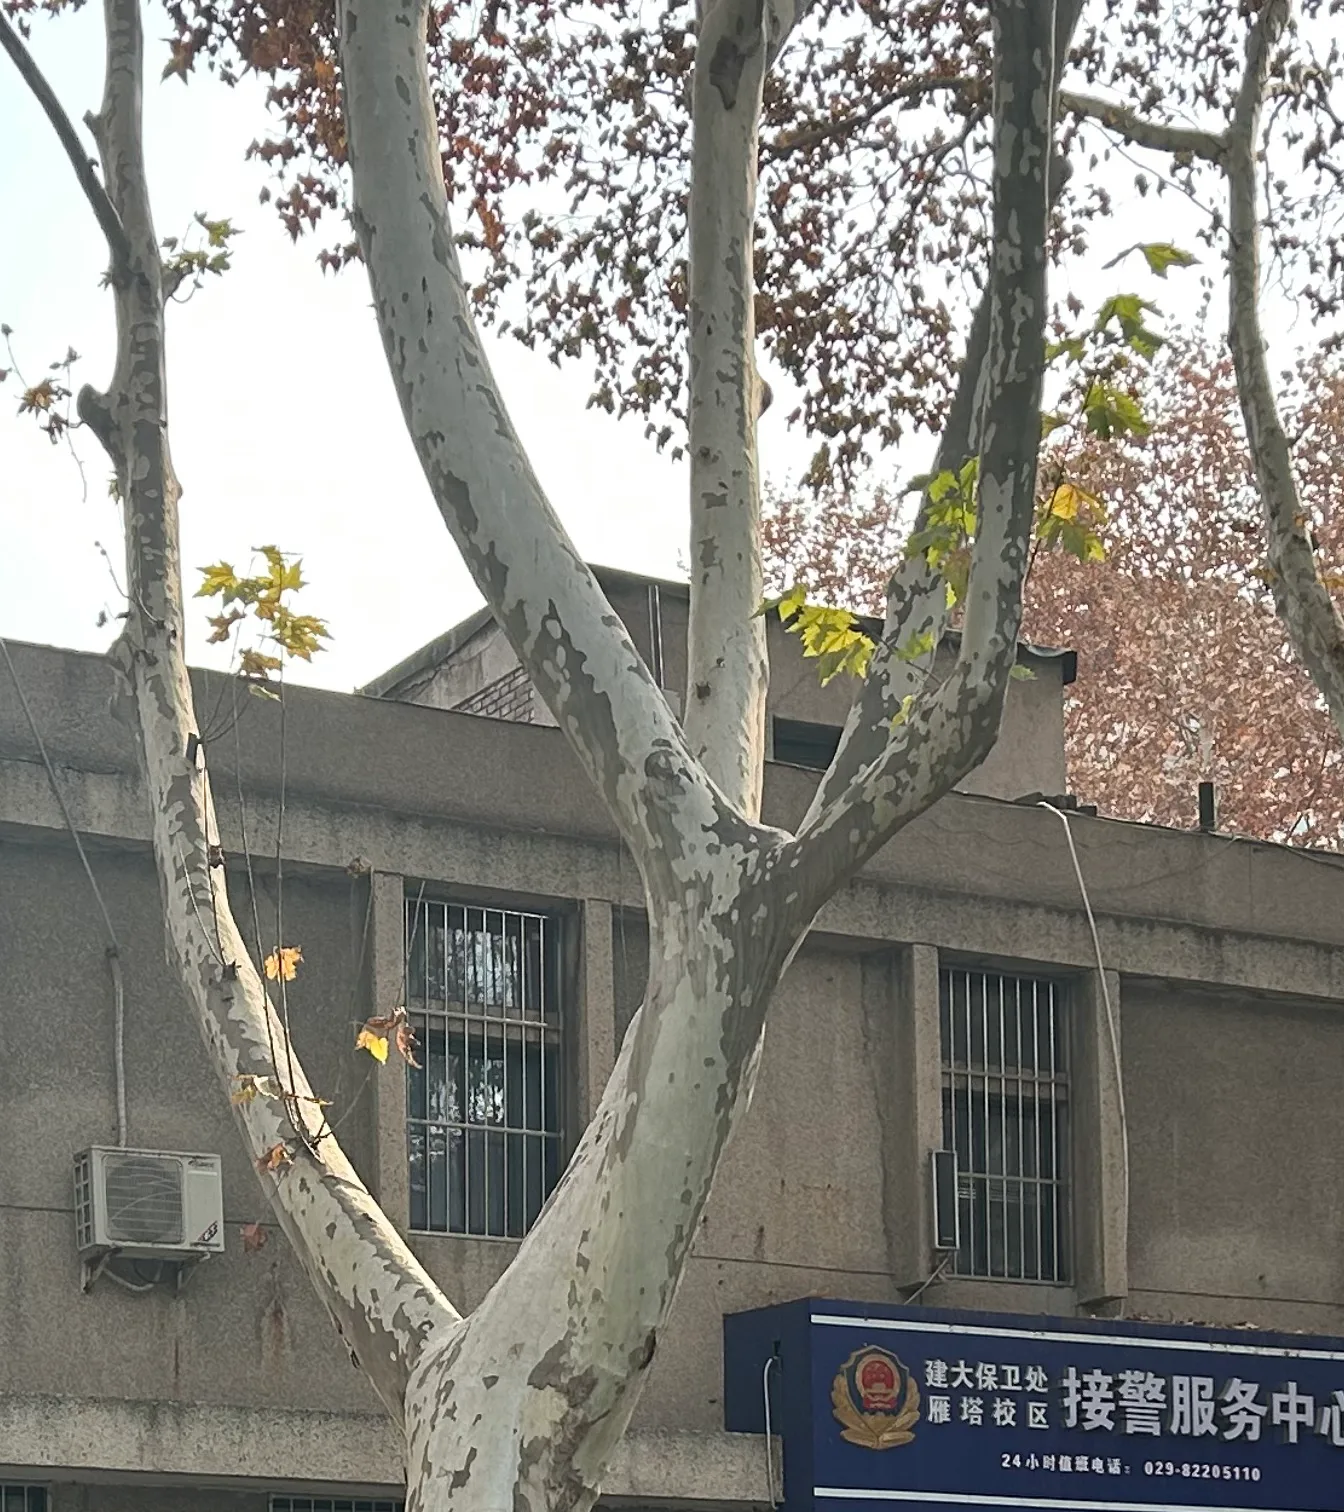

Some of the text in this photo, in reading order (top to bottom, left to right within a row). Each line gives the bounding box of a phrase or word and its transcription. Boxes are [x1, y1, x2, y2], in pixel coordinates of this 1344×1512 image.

[925, 1359, 1049, 1392] 建大保卫处
[927, 1396, 1050, 1429] 雁塔校区
[1144, 1461, 1261, 1482] 029-82205110
